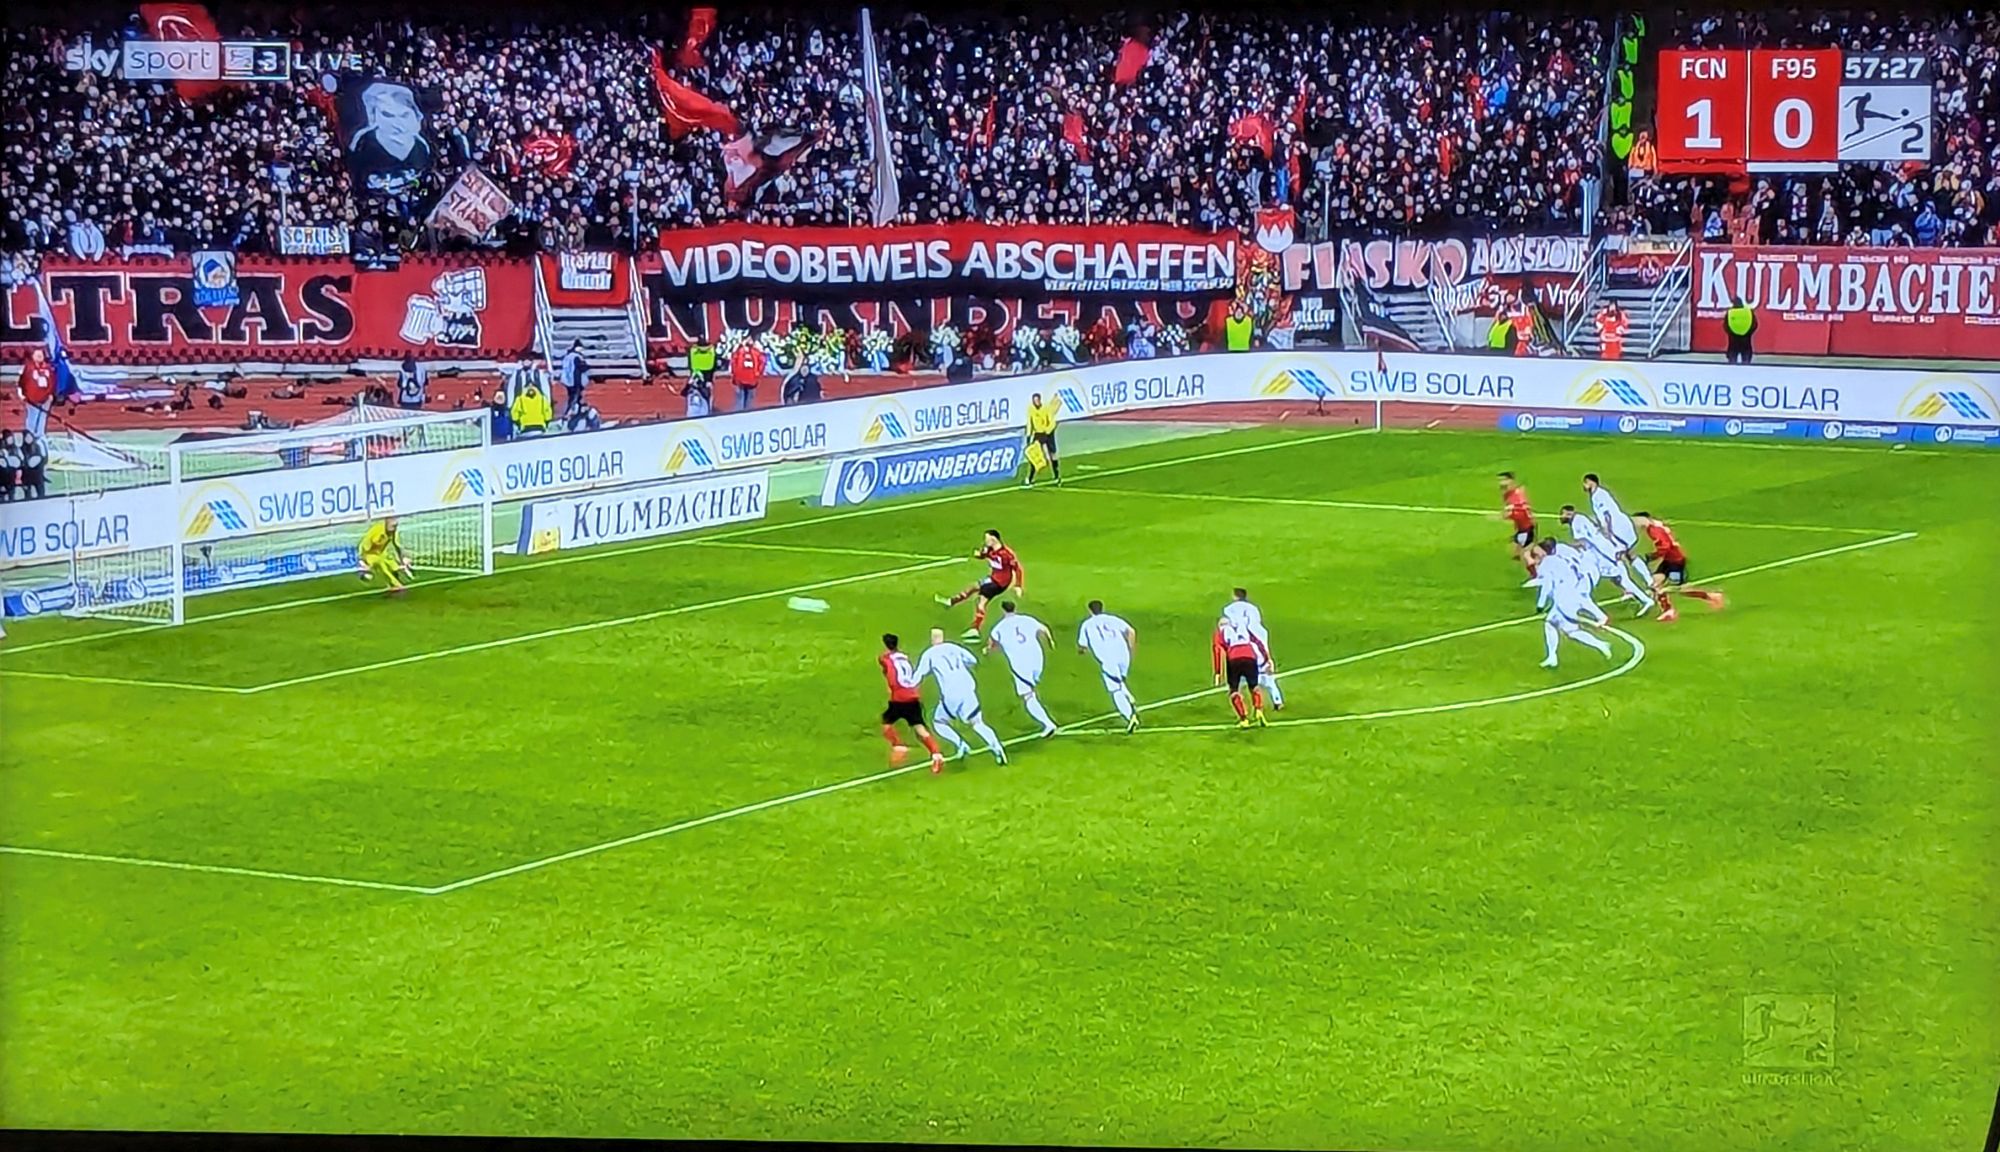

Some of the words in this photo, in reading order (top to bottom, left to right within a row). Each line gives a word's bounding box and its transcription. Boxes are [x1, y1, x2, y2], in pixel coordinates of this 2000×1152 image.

[65, 37, 120, 77] sky
[130, 49, 212, 77] sport
[262, 51, 277, 71] 3
[294, 54, 363, 70] LIVE
[1680, 58, 1727, 79] FCN
[1771, 58, 1817, 79] F95
[1845, 57, 1926, 79] 57:27
[1684, 99, 1722, 149] 1
[1773, 98, 1813, 149] 0
[1901, 122, 1924, 153] 2
[660, 240, 953, 287] VIDEOBEWEIS
[961, 240, 1235, 280] ABSCHAFFEN
[1091, 381, 1128, 407] SWB
[1135, 374, 1205, 401] SOLAR
[1351, 370, 1418, 393] SWB
[1426, 373, 1515, 398] SOLAR
[1663, 382, 1732, 406] SWB
[1742, 385, 1840, 411] SOLAR
[915, 406, 951, 433] SWB
[956, 398, 1009, 426] SOLAR
[722, 431, 764, 460] SWB
[769, 423, 826, 453] SOLAR
[506, 460, 553, 490] SWB
[560, 450, 624, 481] SOLAR
[258, 490, 314, 523] SWB
[321, 481, 394, 516] SOLAR
[571, 483, 761, 541] KULMBACHER
[45, 514, 130, 552] SOLAR
